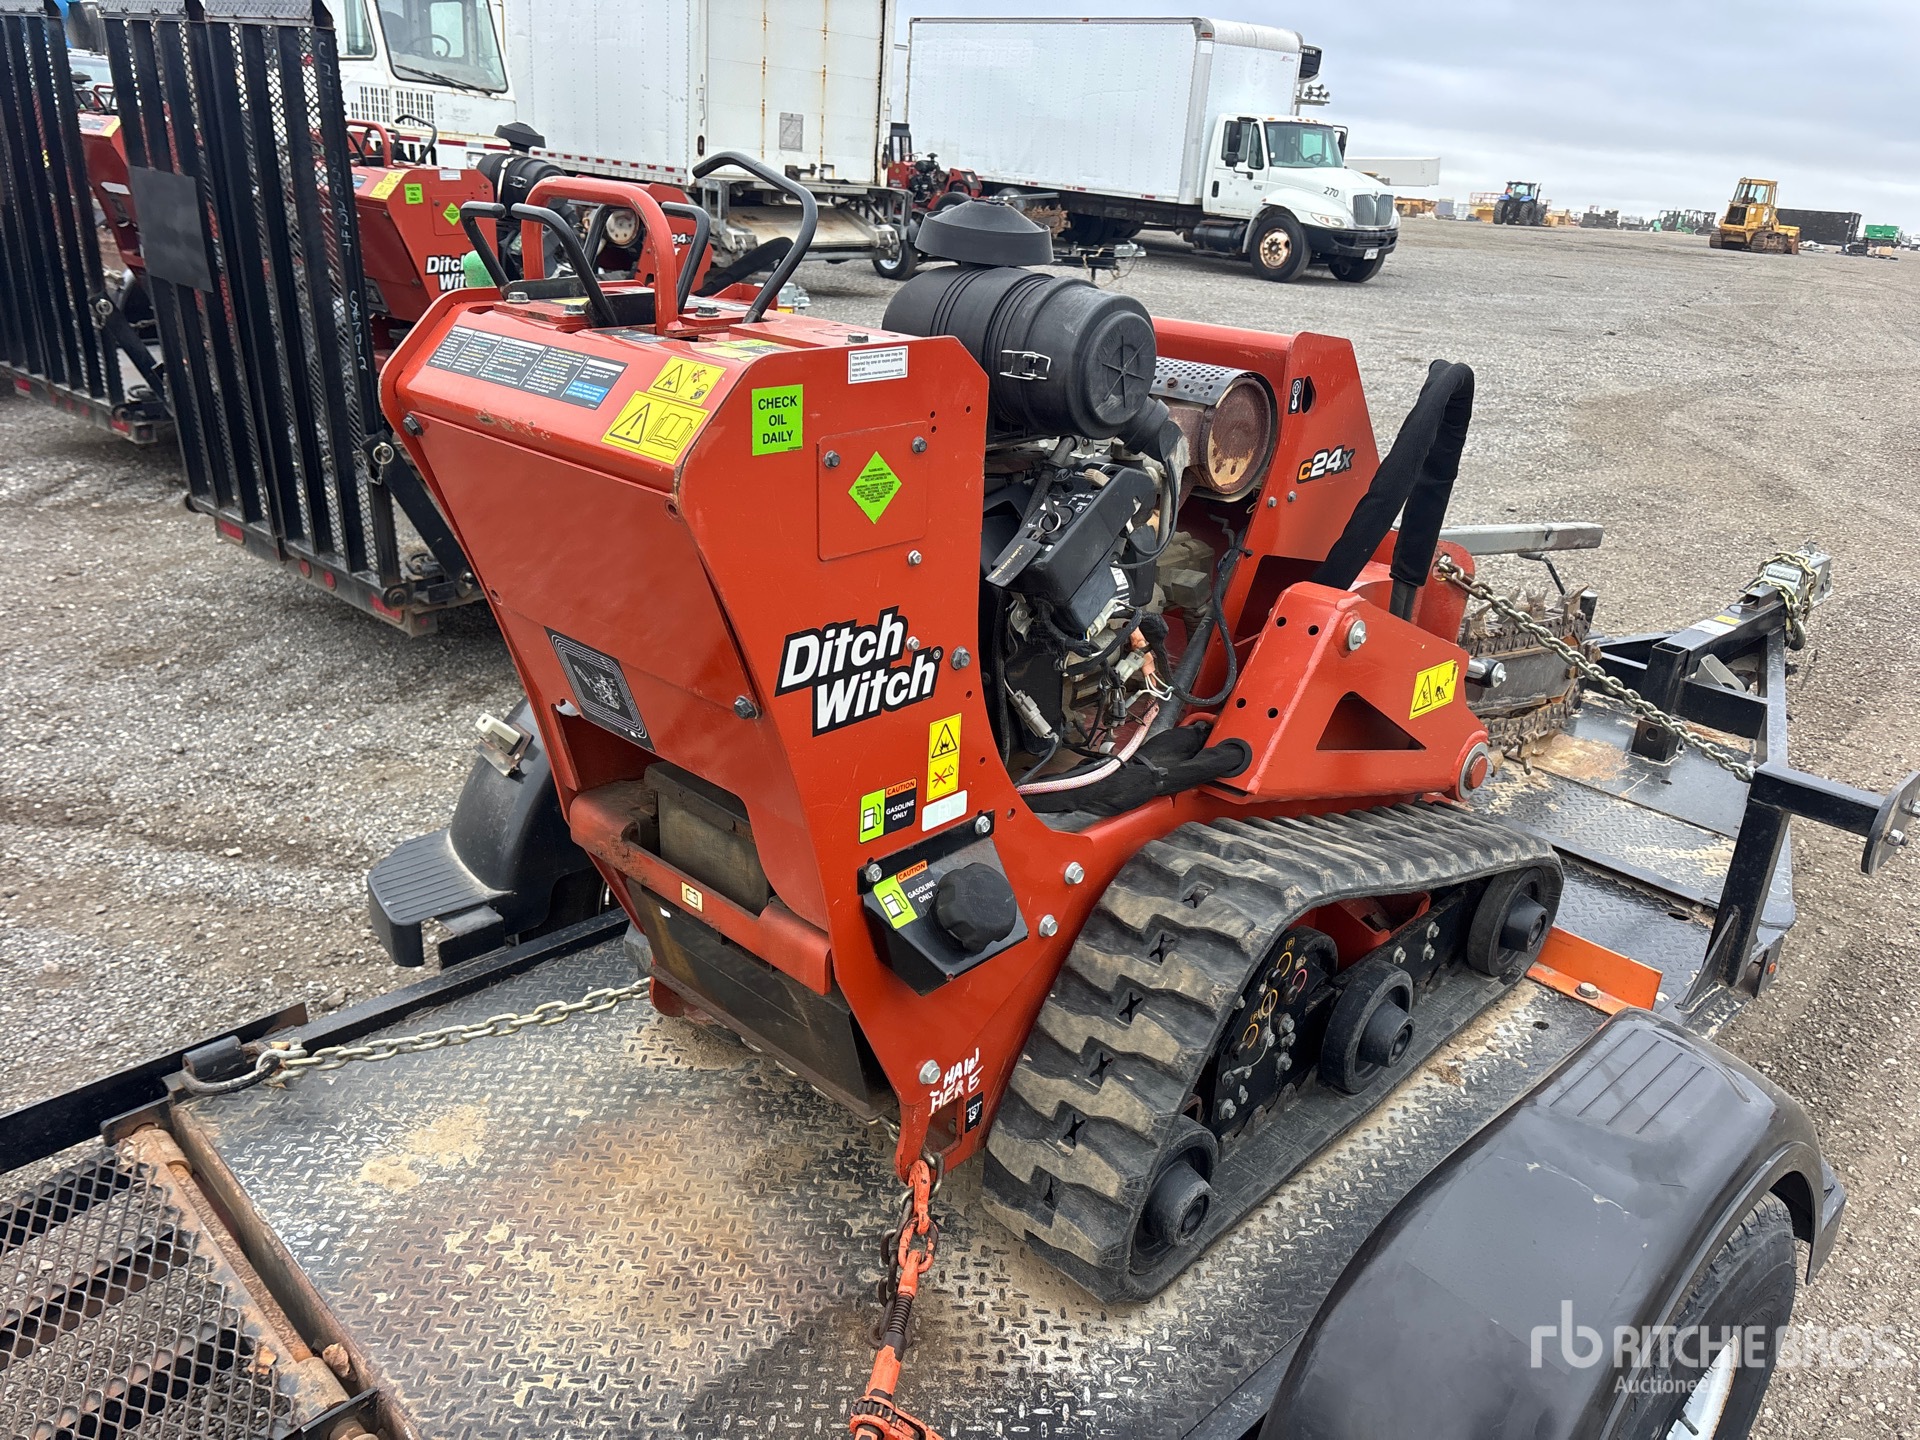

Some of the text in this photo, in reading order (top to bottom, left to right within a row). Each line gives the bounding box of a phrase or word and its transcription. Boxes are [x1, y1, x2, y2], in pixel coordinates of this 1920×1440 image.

[1323, 186, 1340, 198] 270
[758, 395, 798, 410] CHECK
[768, 414, 788, 427] OIL
[762, 430, 794, 445] DAILY
[780, 611, 905, 690] Ditch
[886, 780, 915, 796] CAUTION
[885, 798, 915, 816] GASOLINE
[891, 809, 908, 821] ONLY
[898, 862, 926, 881] CAUTION
[907, 879, 937, 900] GASOLINE
[918, 890, 934, 904] ONLY
[928, 1065, 984, 1117] HERE
